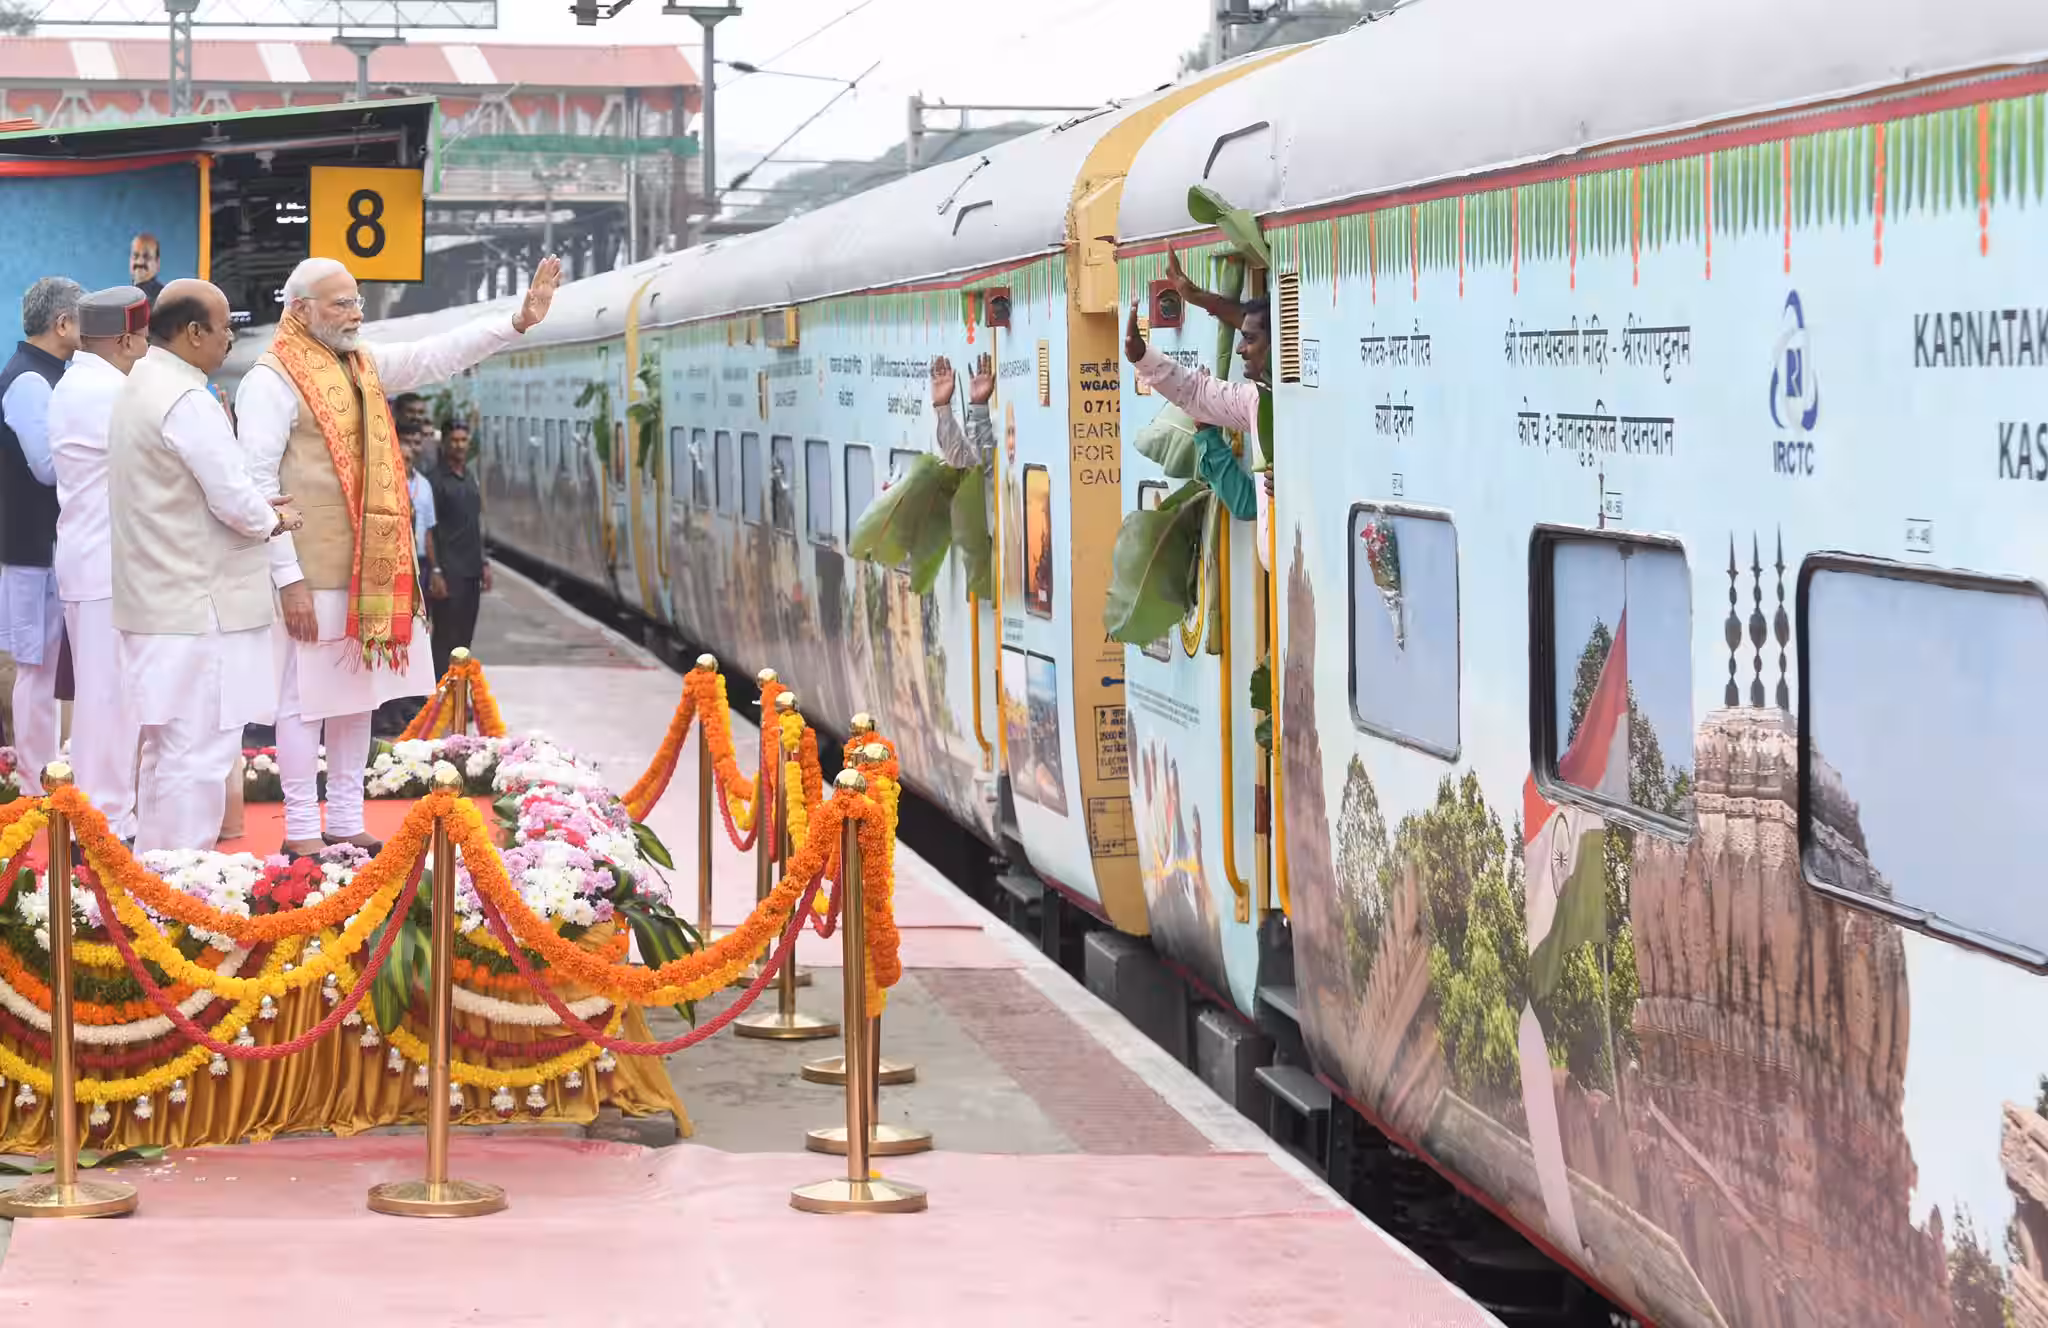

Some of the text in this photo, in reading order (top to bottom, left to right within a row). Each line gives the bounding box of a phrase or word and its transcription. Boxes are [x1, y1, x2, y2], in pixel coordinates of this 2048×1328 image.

[346, 189, 386, 258] 8
[1582, 313, 1608, 376] मंदिर
[1914, 308, 2048, 367] KARNATAK
[1080, 380, 1120, 391] WGAC
[1073, 444, 1114, 461] FOR
[1620, 416, 1674, 456] शयनयान
[1773, 440, 1815, 476] IRCTC
